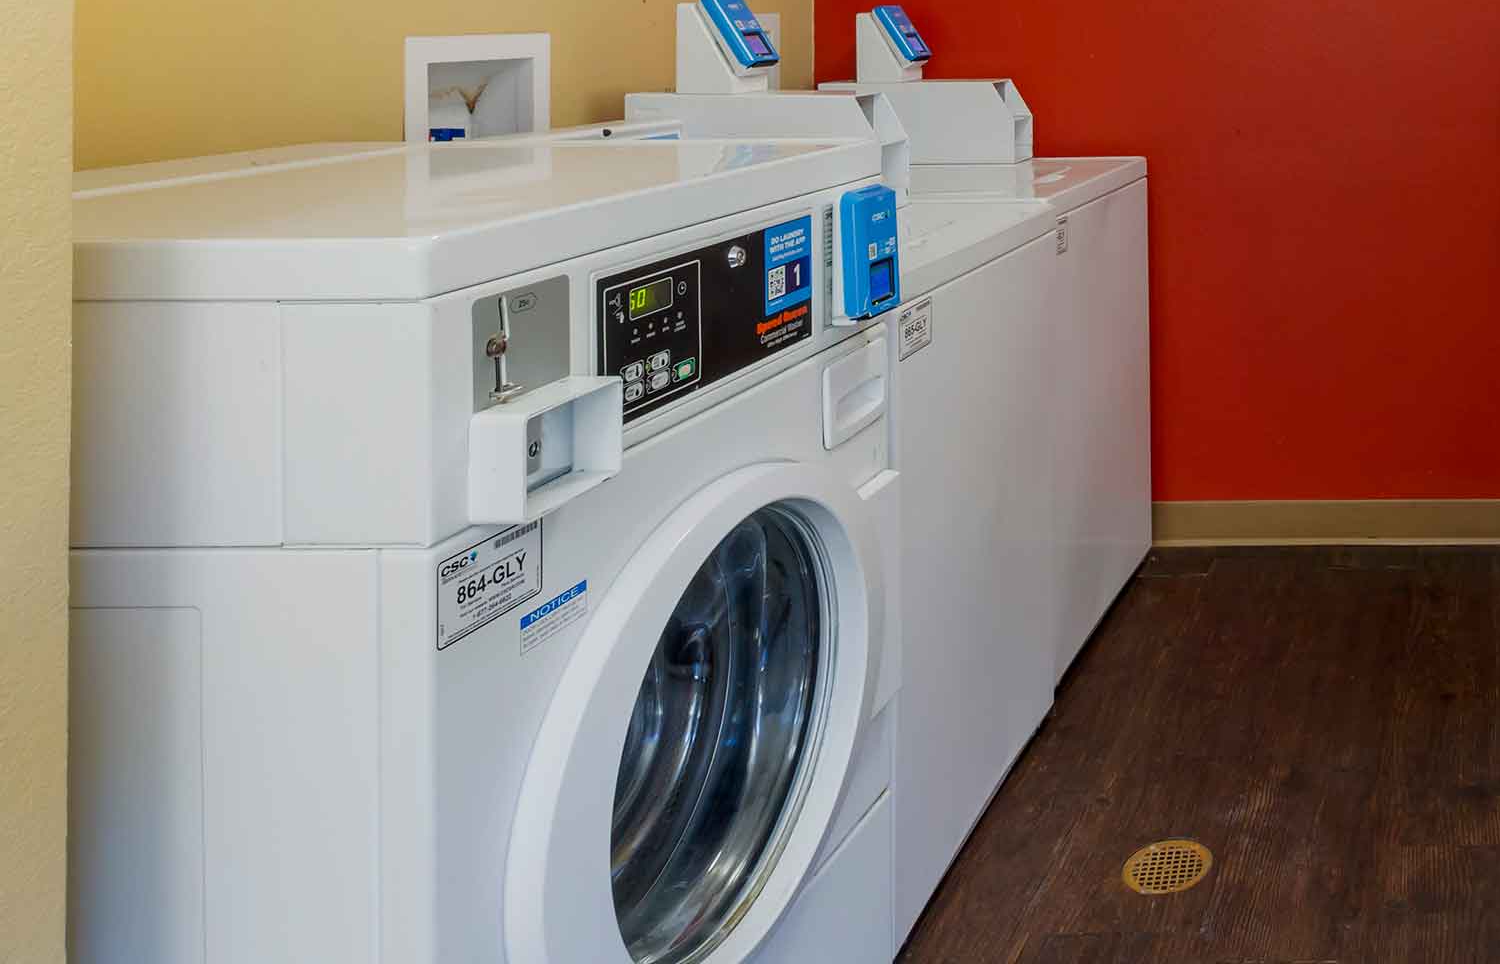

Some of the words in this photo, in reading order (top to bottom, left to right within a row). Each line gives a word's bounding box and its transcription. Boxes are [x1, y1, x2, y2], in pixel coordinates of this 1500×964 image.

[793, 263, 800, 286] 1
[441, 556, 469, 577] CSC
[457, 552, 527, 604] 864-GLY
[530, 586, 579, 623] NOTICE
